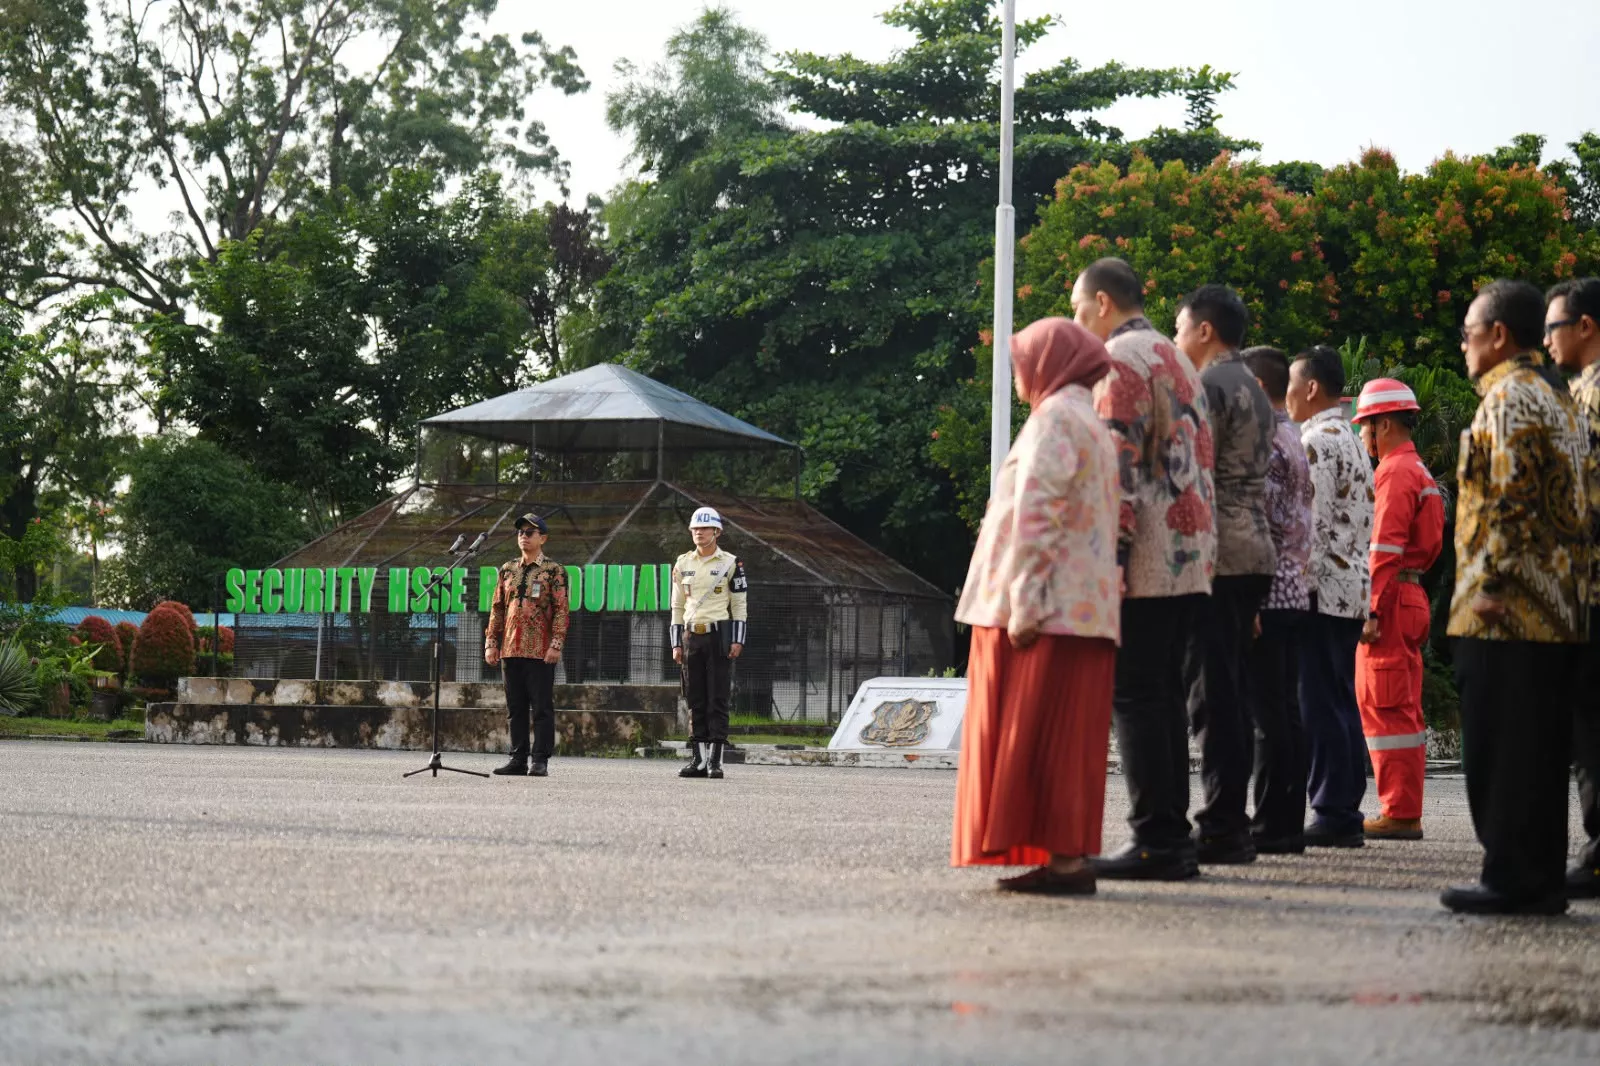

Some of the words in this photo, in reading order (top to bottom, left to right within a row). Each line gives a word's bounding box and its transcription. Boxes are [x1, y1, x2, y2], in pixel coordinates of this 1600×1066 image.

[225, 567, 378, 614] SECURITY
[388, 566, 468, 614] HSSE
[564, 563, 672, 612] DUMAI
